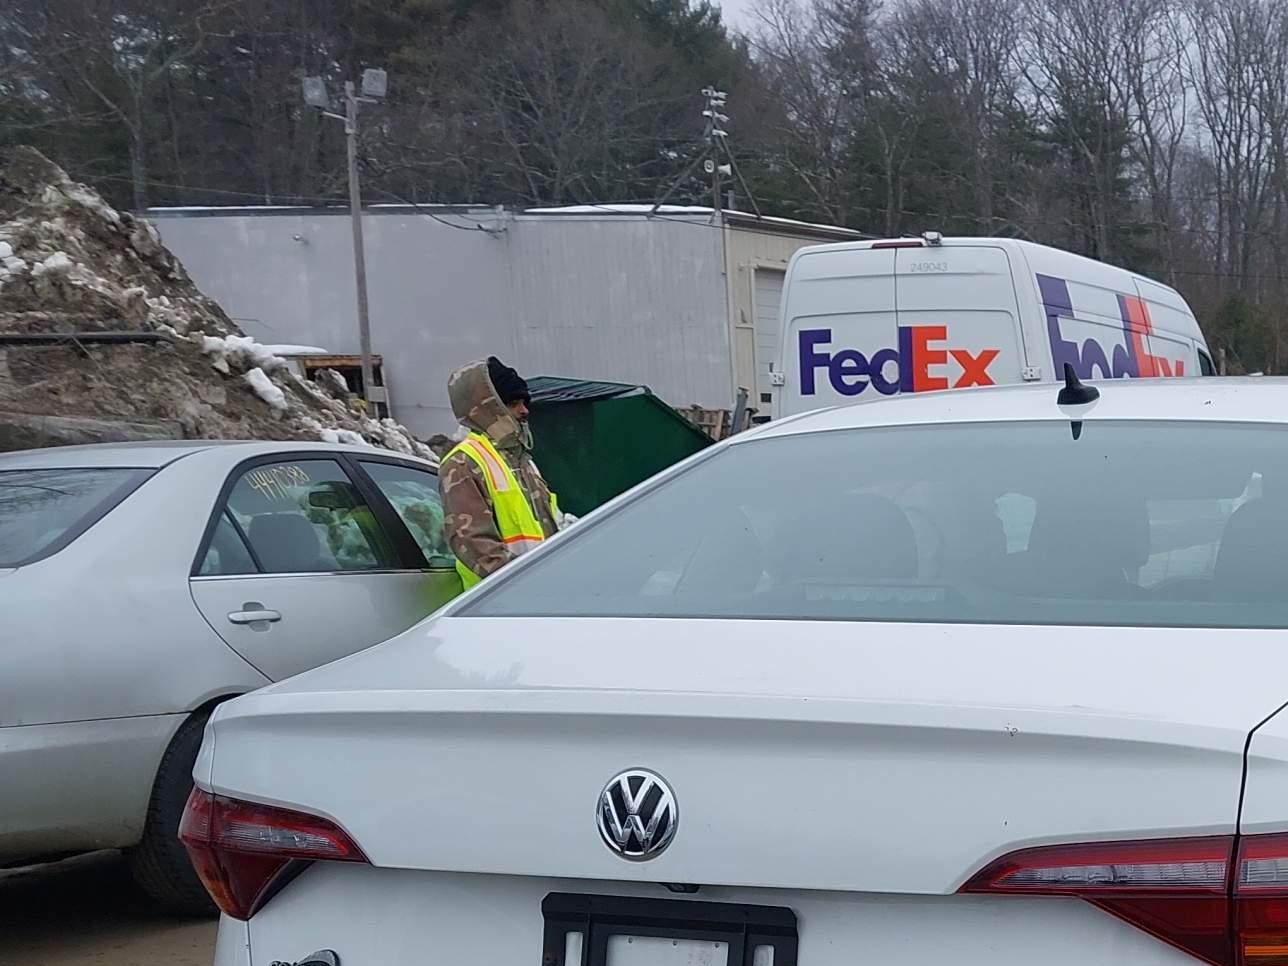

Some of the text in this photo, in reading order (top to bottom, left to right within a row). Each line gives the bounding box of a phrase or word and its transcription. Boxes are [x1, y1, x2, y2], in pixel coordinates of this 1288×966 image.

[798, 326, 1000, 396] FedEx
[1035, 272, 1184, 381] FdE
[598, 768, 678, 860] VW
